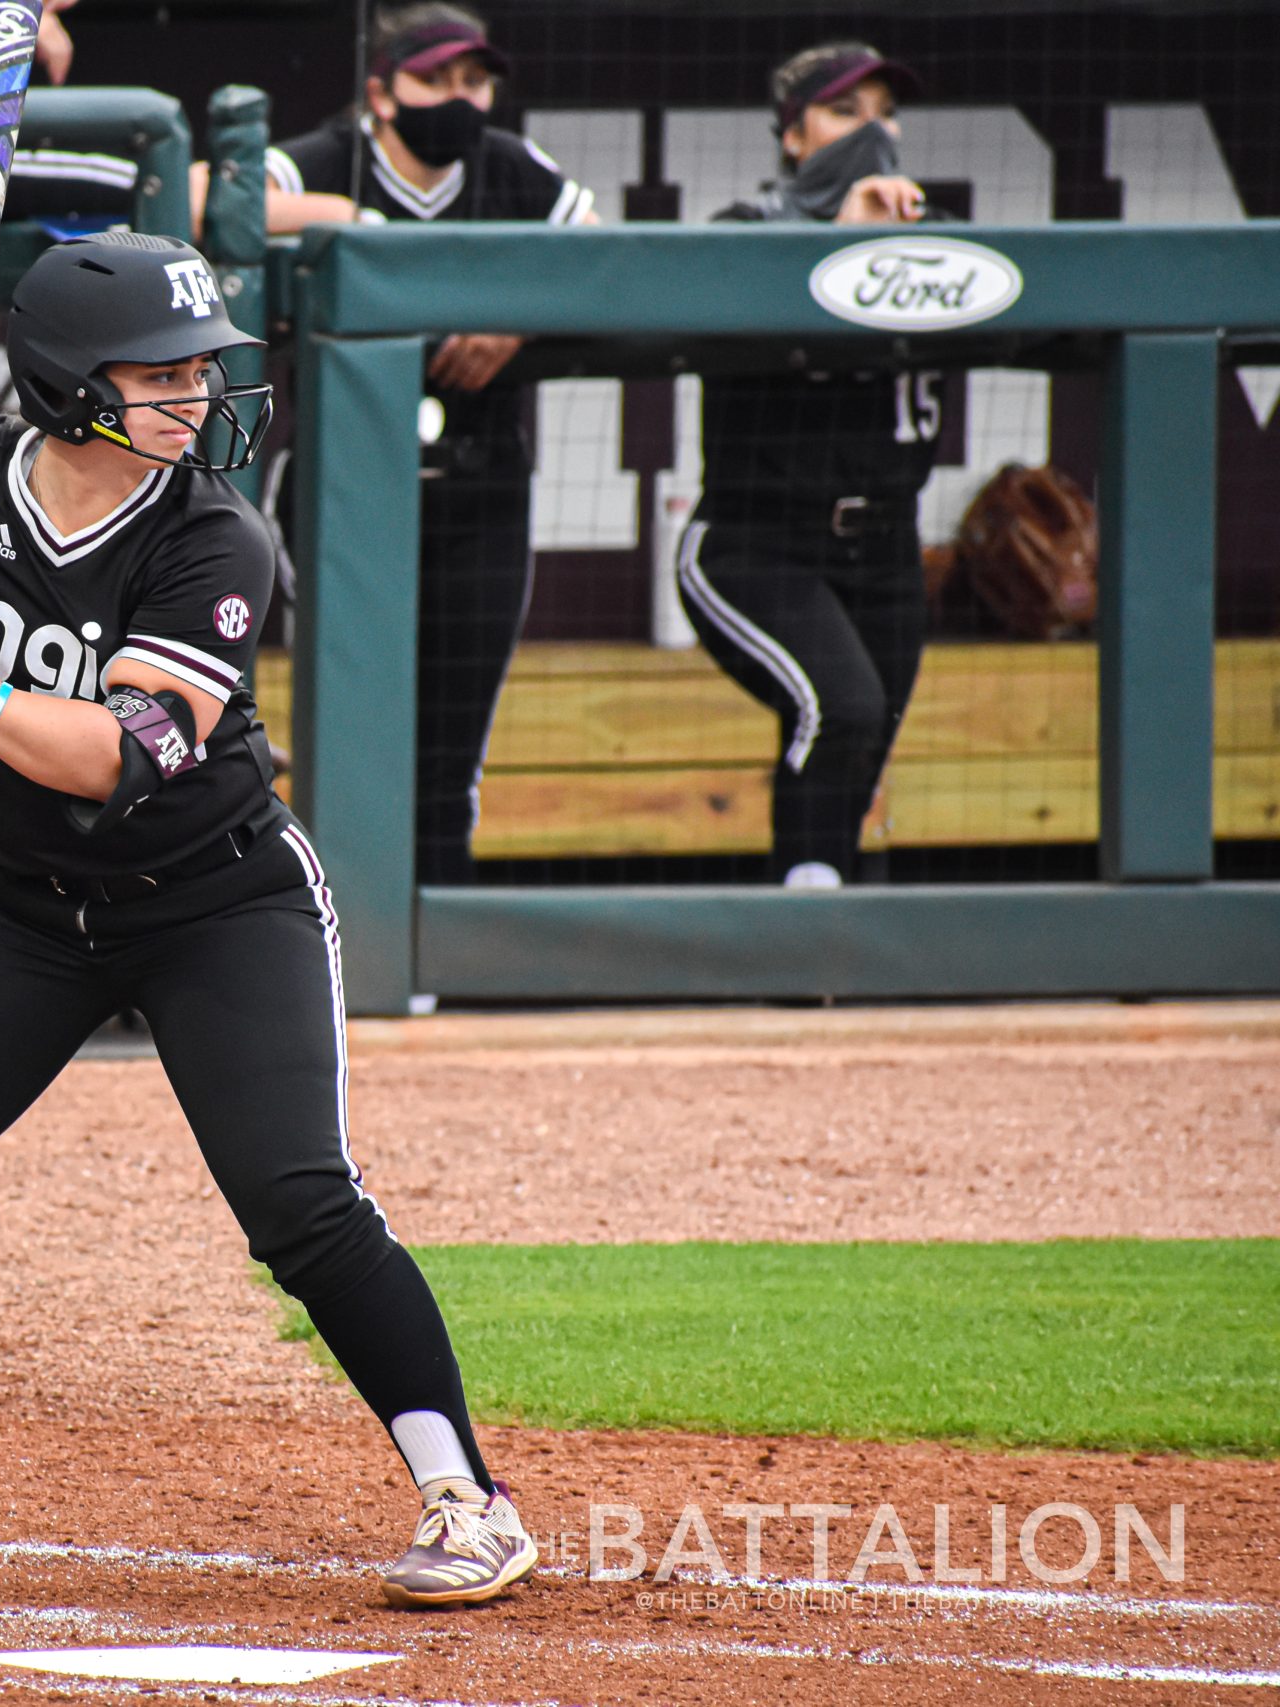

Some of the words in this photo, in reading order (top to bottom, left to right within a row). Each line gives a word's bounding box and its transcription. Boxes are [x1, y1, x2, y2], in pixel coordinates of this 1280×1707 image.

[854, 252, 978, 309] Ford
[895, 371, 941, 442] 15
[218, 598, 250, 639] SEC
